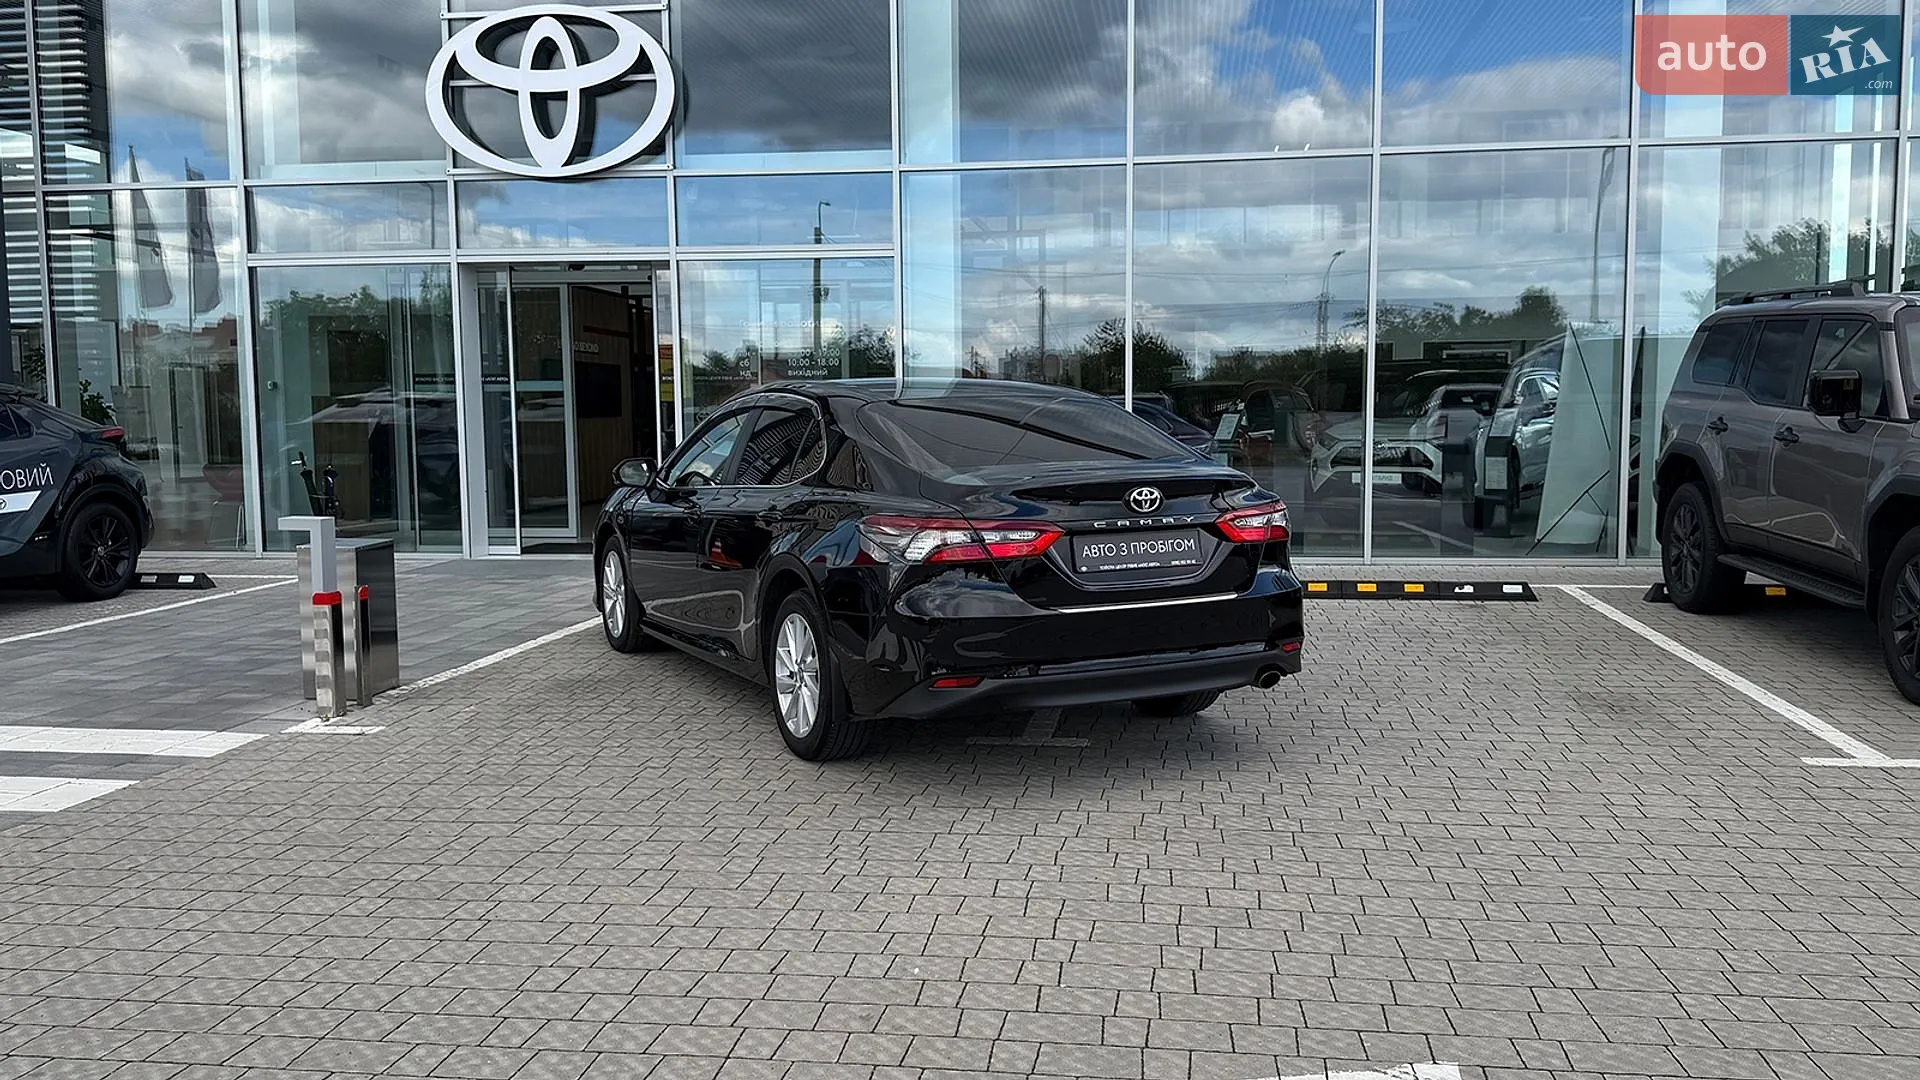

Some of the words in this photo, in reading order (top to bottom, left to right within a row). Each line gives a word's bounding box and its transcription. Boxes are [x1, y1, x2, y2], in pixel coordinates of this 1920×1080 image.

[787, 367, 828, 377] вихідний
[0, 463, 54, 490] ОВИЙ
[1093, 515, 1195, 528] CAMRY
[1082, 543, 1116, 558] АВТО
[1130, 538, 1196, 555] ПРОБІГОМ
